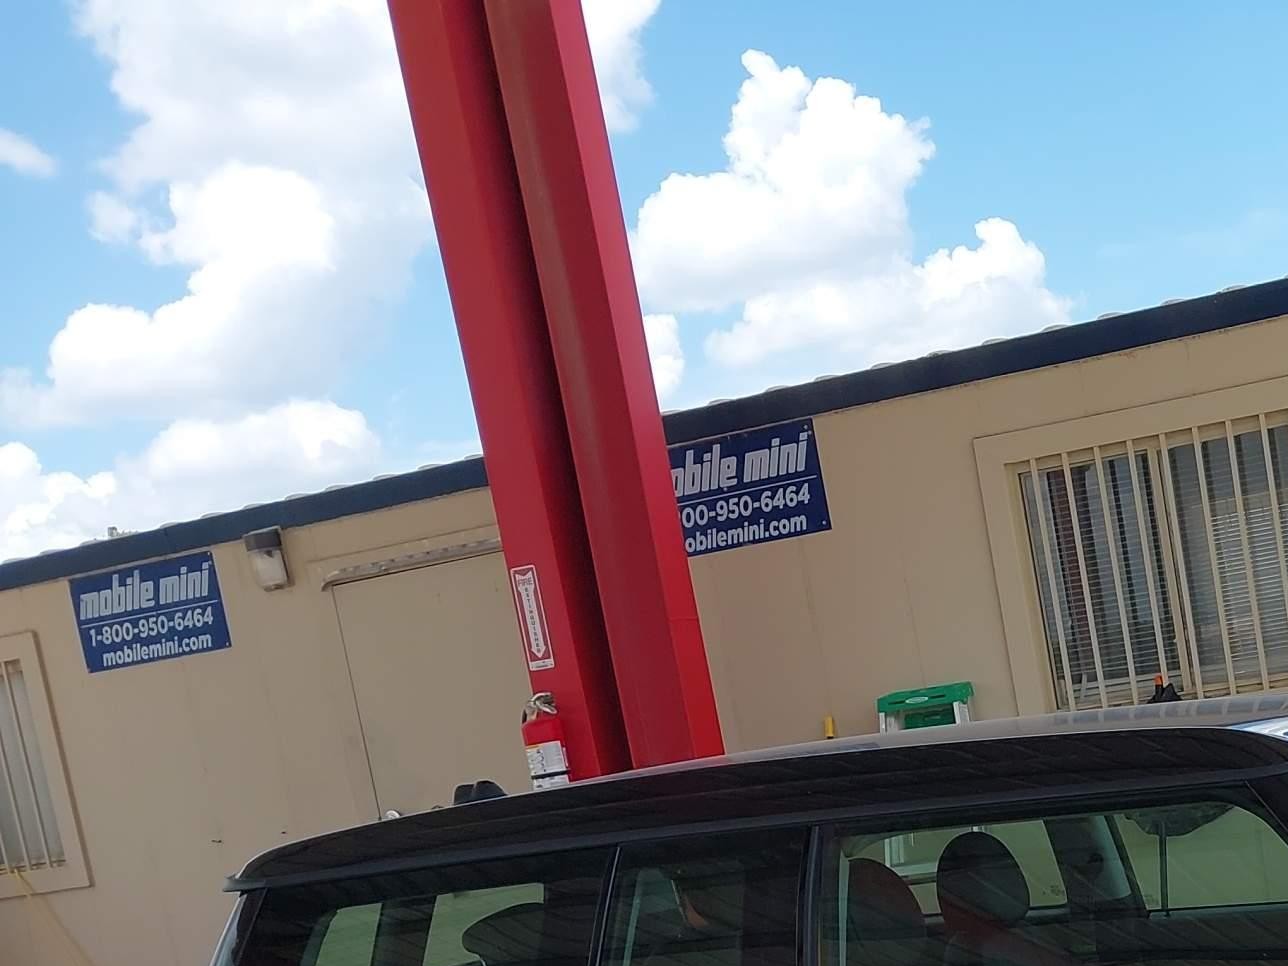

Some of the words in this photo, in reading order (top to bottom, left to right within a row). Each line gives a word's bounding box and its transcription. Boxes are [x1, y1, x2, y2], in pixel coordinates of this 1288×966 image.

[671, 443, 738, 498] obile
[743, 431, 808, 484] mini
[681, 482, 811, 529] 00-950-6464
[685, 514, 808, 554] obilemini.com
[79, 569, 155, 621] mobile
[159, 561, 210, 605] mini
[89, 605, 214, 648] 1-800-950-6464
[103, 633, 213, 668] mobilemini.com
